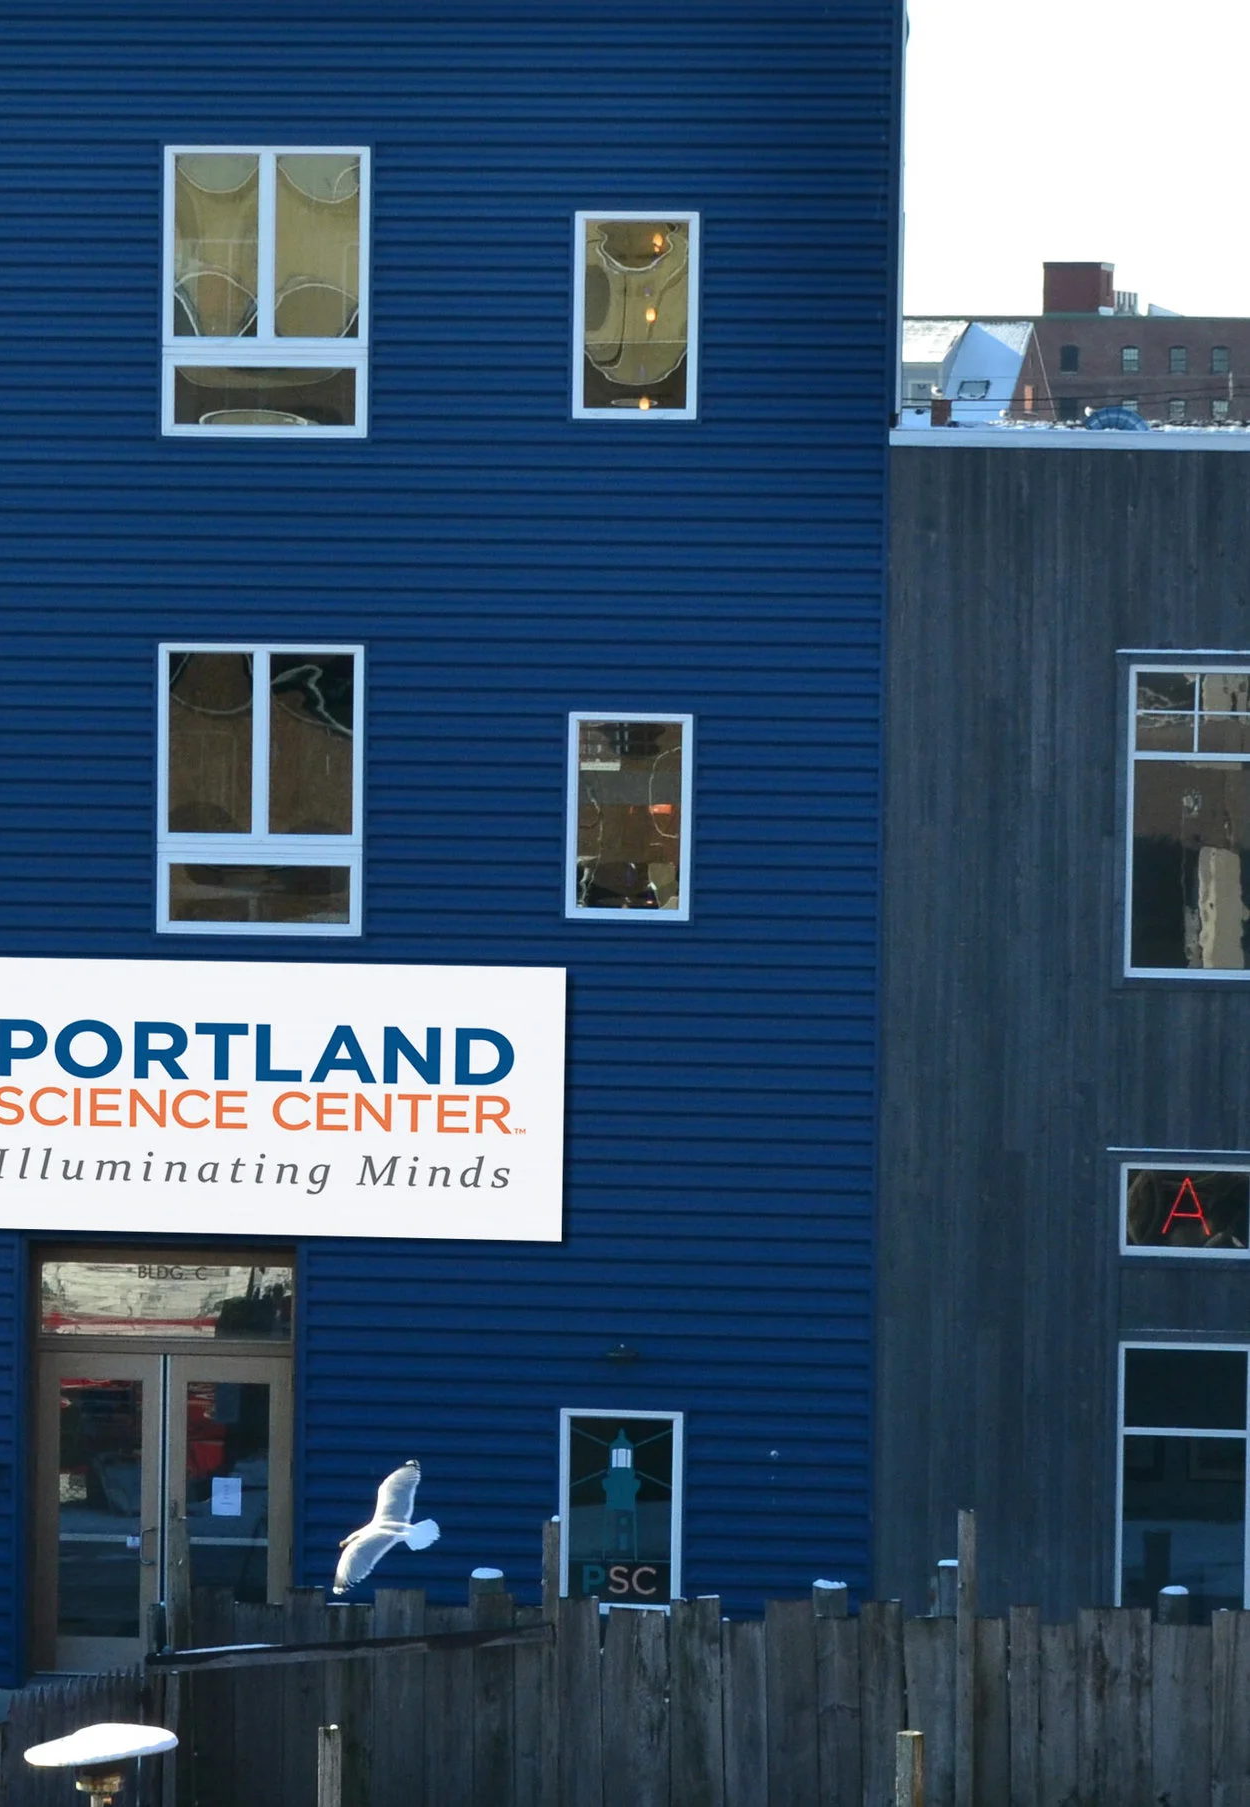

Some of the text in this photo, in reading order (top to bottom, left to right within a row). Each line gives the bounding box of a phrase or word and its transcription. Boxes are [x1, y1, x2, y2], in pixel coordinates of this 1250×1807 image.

[271, 1090, 512, 1135] CENTER
[356, 1155, 511, 1189] Minds
[1162, 1176, 1211, 1236] A
[137, 1265, 208, 1281] BLDG. C
[582, 1564, 657, 1596] PSC
